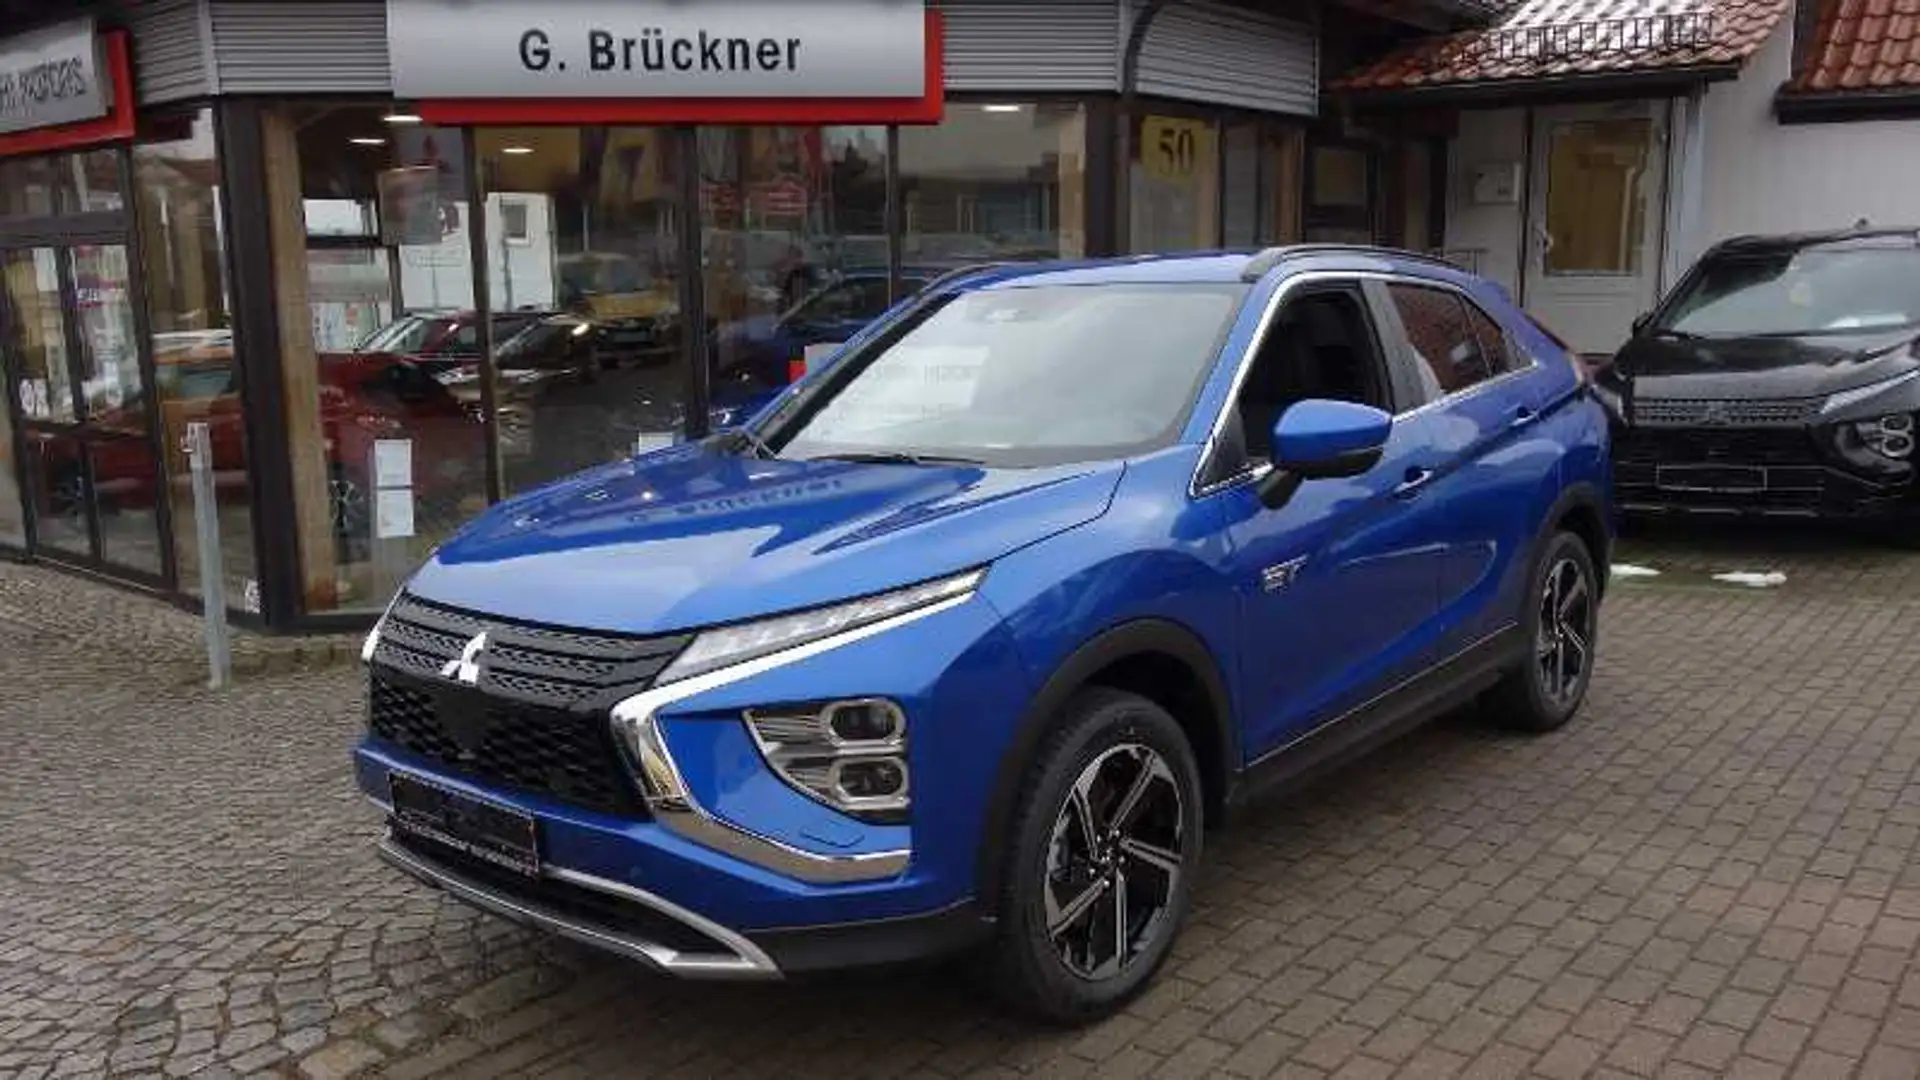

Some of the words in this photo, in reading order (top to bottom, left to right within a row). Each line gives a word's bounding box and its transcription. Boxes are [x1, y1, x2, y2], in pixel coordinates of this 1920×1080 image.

[519, 28, 566, 71] G.
[588, 28, 801, 71] Brückner
[1159, 127, 1195, 177] 50
